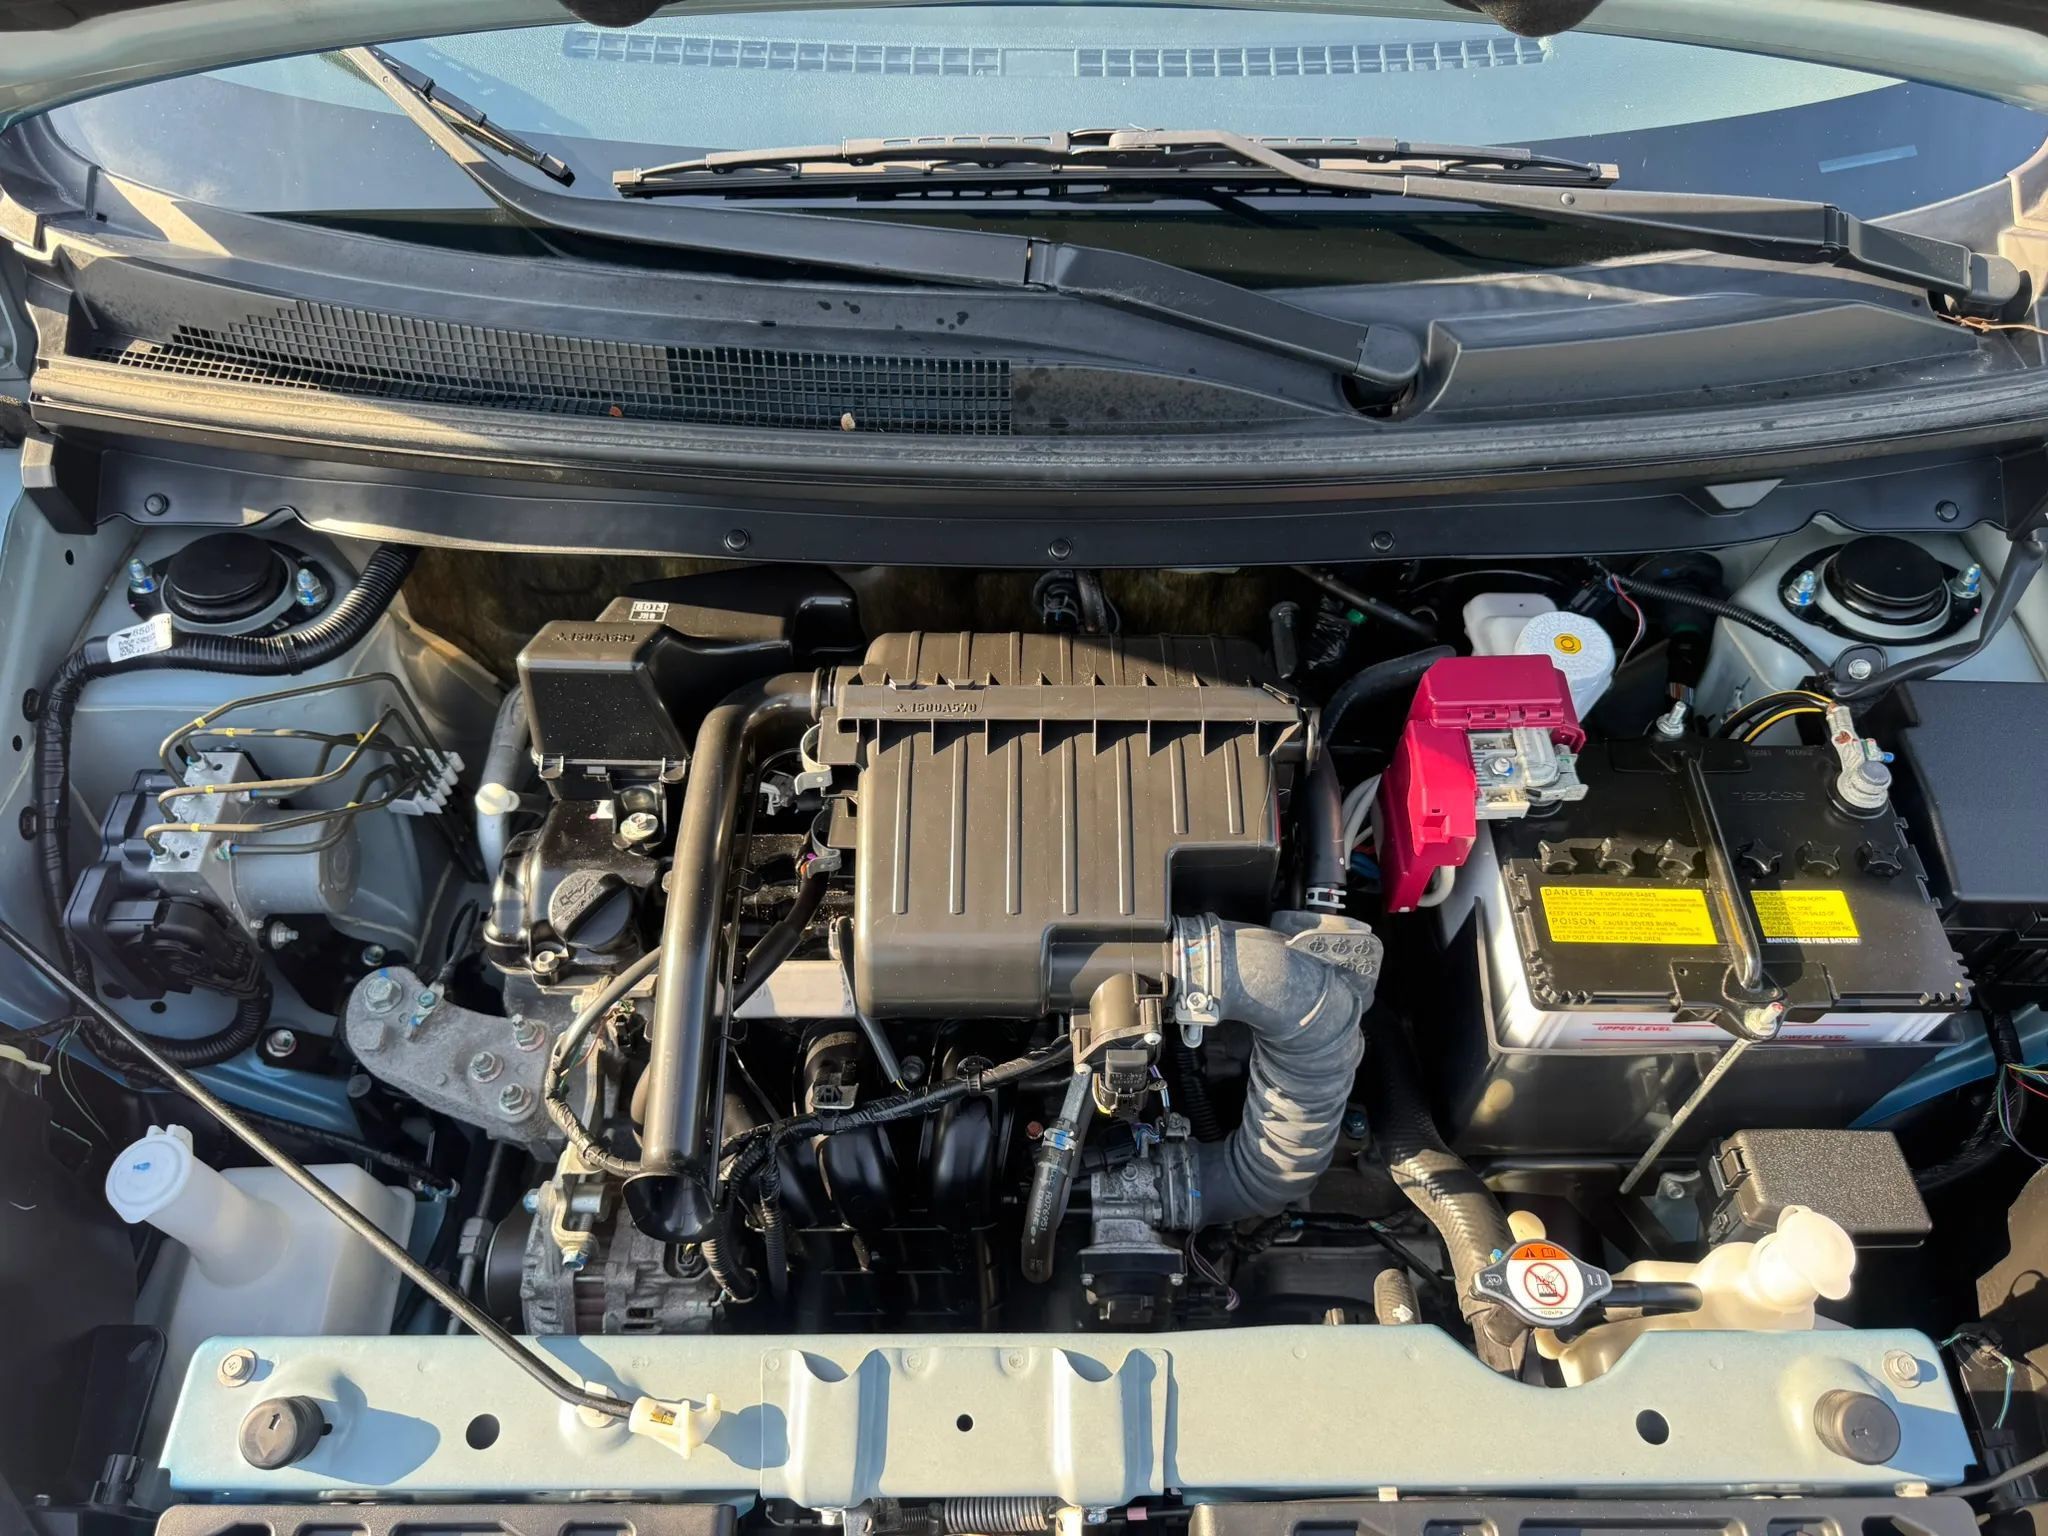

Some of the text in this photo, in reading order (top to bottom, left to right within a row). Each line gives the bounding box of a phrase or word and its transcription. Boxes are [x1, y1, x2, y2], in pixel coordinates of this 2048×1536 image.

[911, 703, 977, 713] 1500A570
[1544, 888, 1594, 897] DANGER
[1552, 917, 1596, 926] POISON
